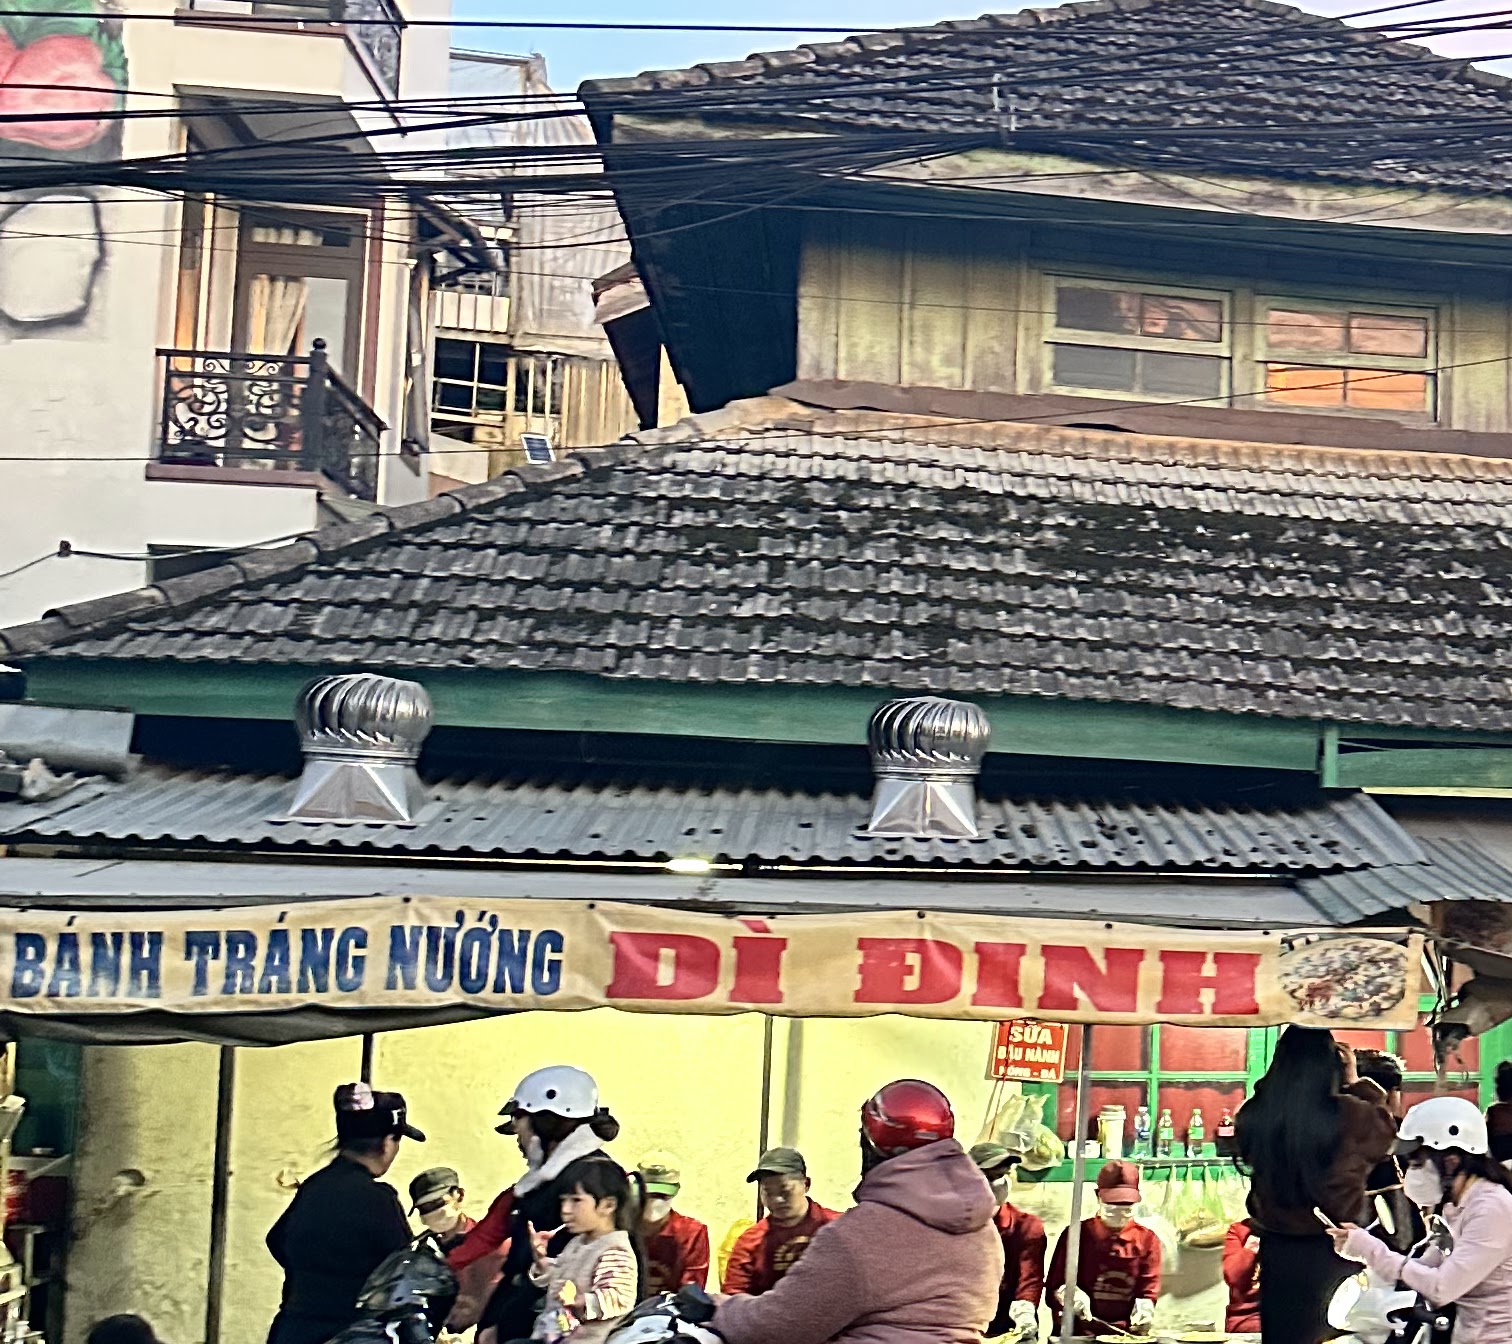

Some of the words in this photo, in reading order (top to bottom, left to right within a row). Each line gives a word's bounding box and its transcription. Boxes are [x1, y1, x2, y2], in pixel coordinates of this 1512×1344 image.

[11, 915, 164, 998] BÁNH
[184, 911, 369, 996] TRÁNG
[385, 909, 565, 995] NƯỚNG
[606, 919, 787, 1004] DÌ
[853, 936, 1261, 1016] ĐINH
